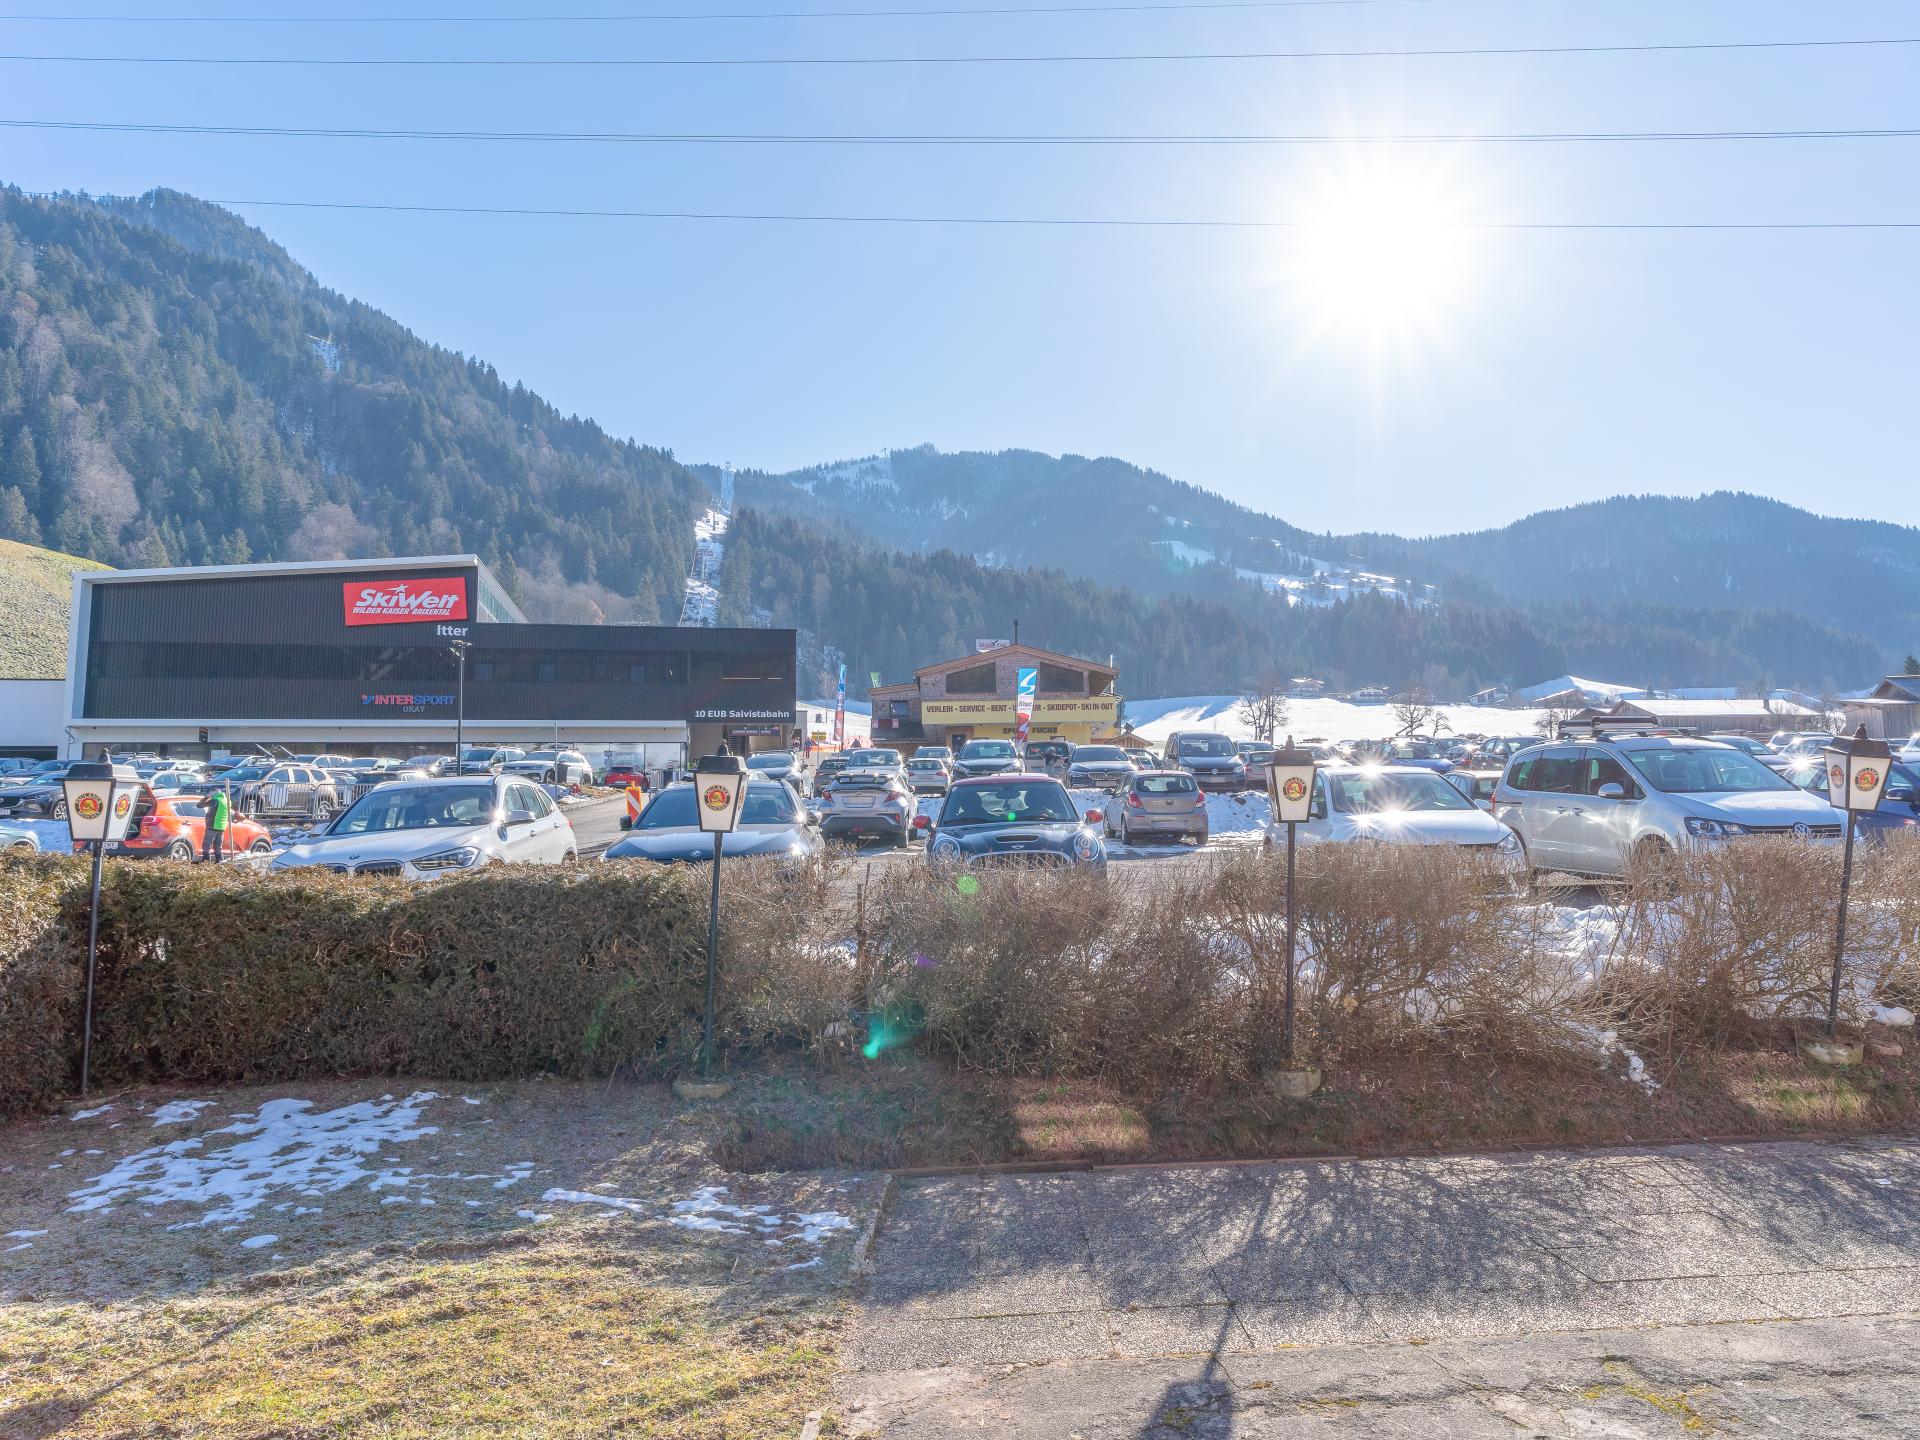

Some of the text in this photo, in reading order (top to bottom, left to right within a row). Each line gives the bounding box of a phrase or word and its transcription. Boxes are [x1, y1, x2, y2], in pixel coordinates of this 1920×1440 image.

[355, 588, 459, 610] SkiWelt
[352, 606, 451, 616] WILDER KAISER BRIXENTAL
[436, 624, 469, 637] Itter
[374, 694, 456, 705] INTERSPORT
[402, 705, 426, 713] OKAY
[926, 705, 954, 713] VERLEIH
[959, 704, 986, 712] SERVICE
[990, 704, 1008, 712] RENT
[1046, 703, 1077, 711] SKIDEPOT
[1100, 702, 1114, 710] OUT
[695, 709, 790, 718] 10 EUB Salvistabahn
